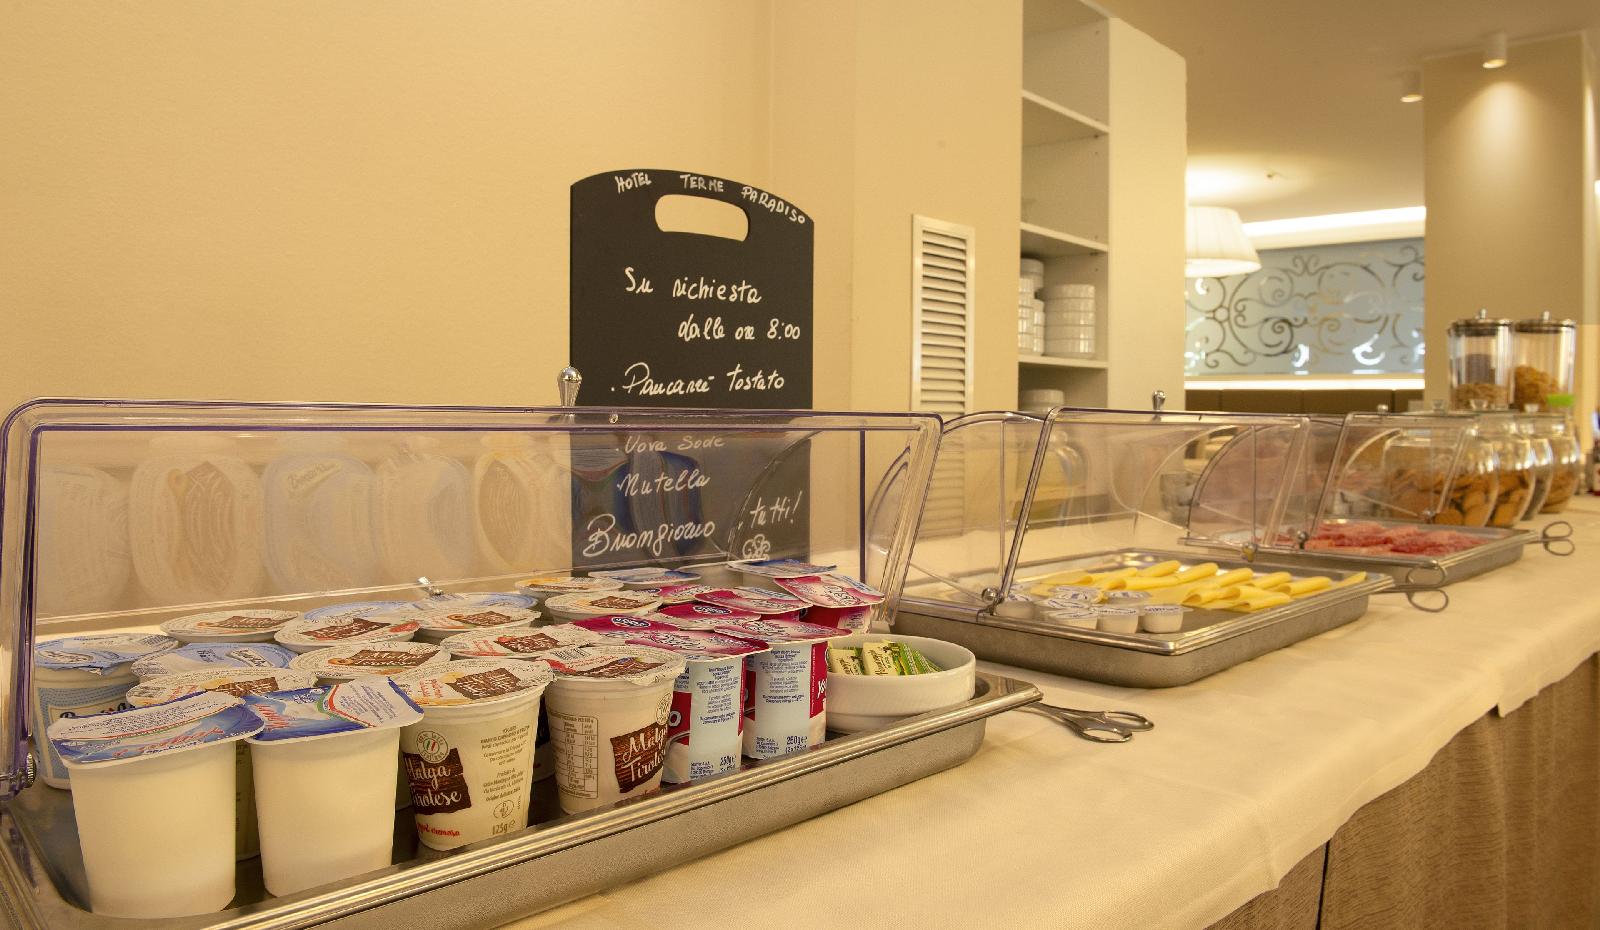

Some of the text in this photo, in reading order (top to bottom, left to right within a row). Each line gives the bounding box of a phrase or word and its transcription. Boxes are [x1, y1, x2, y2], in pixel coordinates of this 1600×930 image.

[615, 172, 806, 225] HOTEL TERME PARADISO
[624, 266, 762, 304] Su richiesta
[678, 313, 725, 342] dalle
[767, 318, 801, 341] 8:00
[677, 435, 725, 451] Sode
[619, 468, 711, 497] Nutella
[582, 513, 716, 558] Buongiorno
